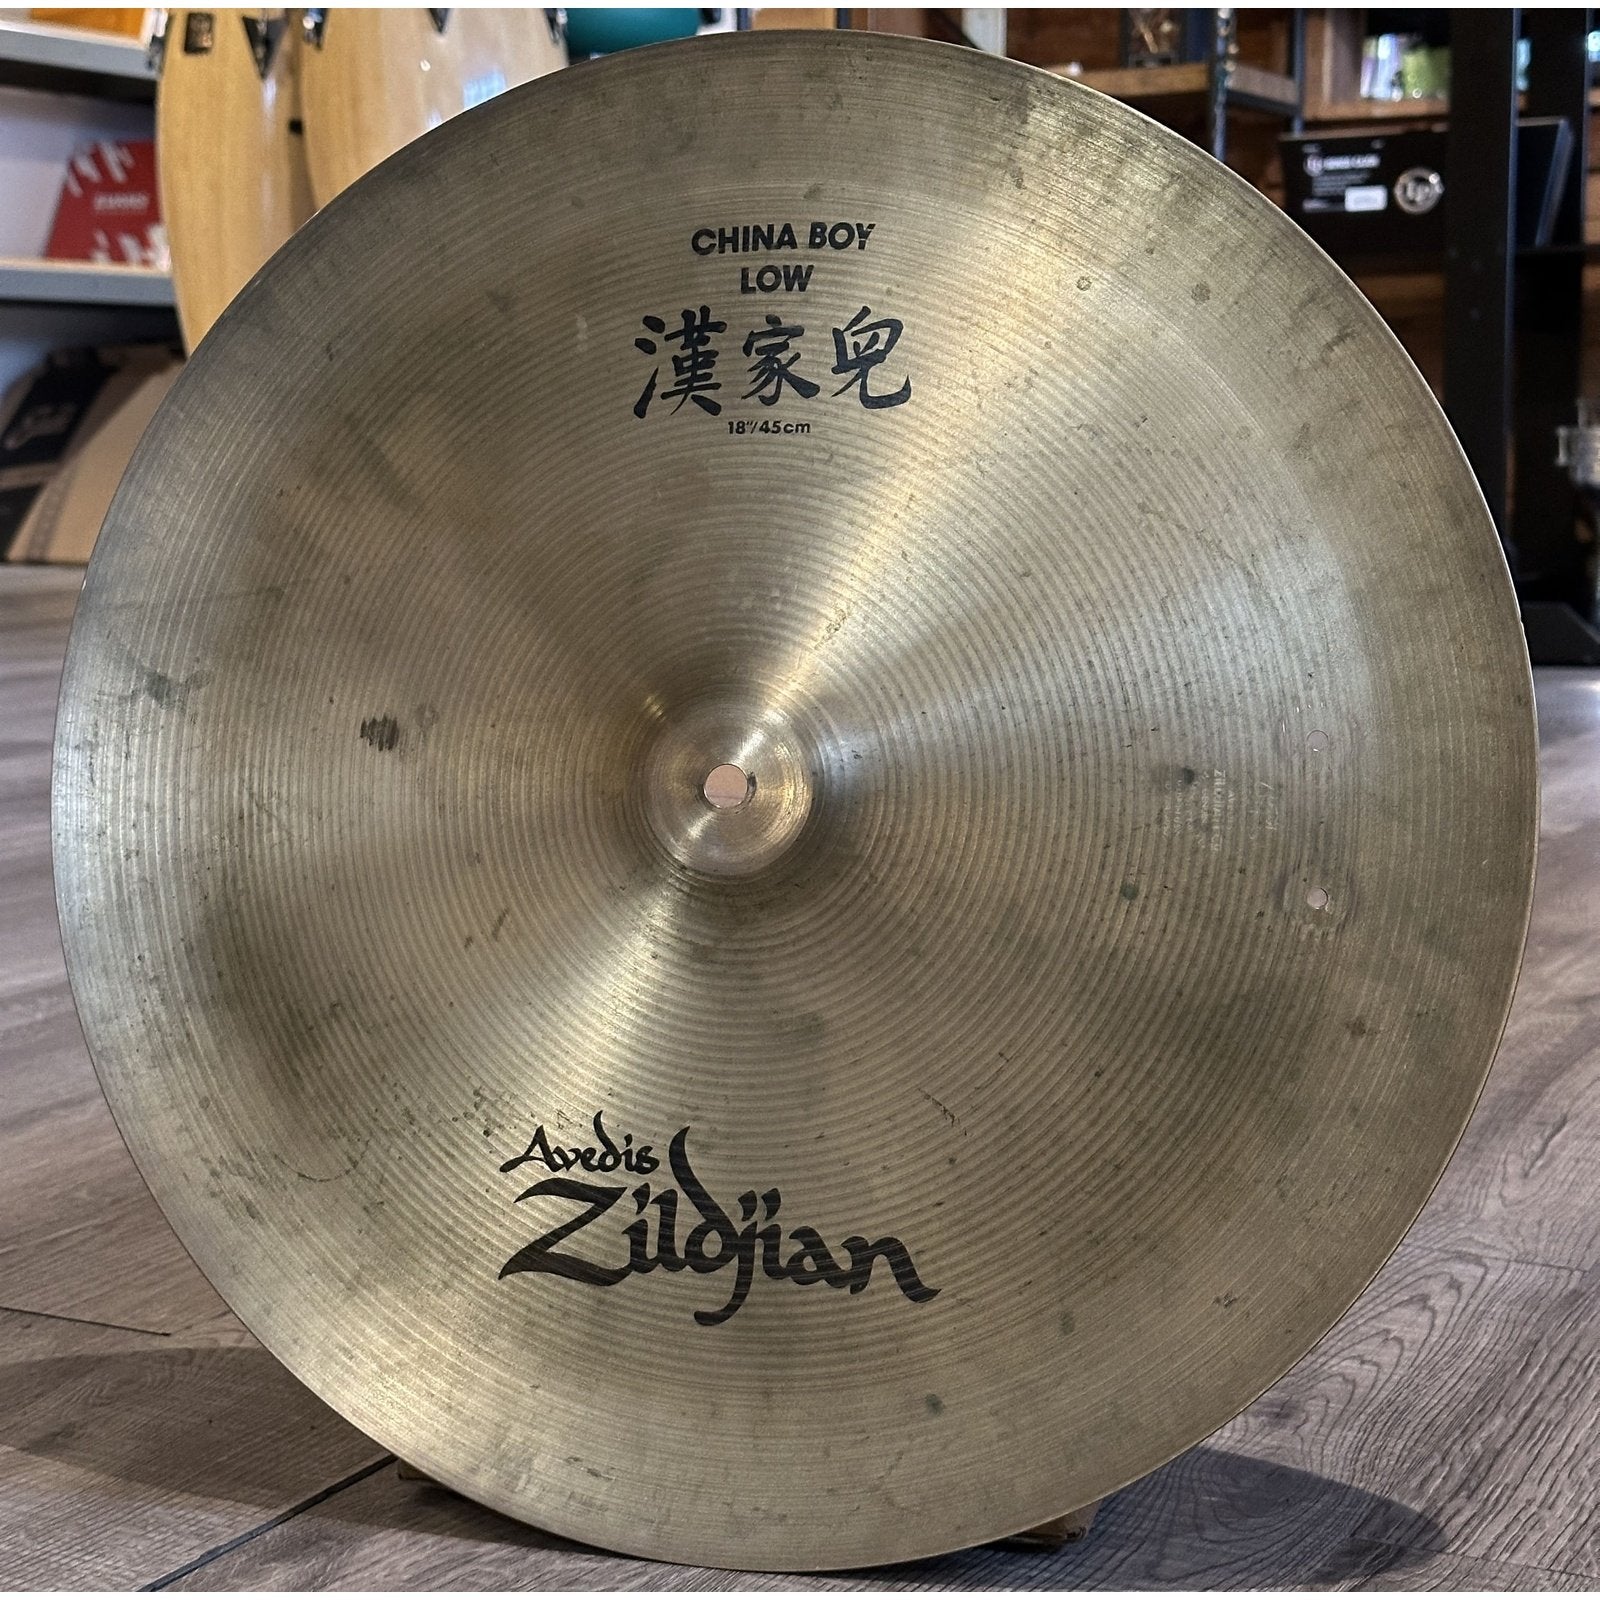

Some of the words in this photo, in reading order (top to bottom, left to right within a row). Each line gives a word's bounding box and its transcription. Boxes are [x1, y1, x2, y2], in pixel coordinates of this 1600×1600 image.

[691, 222, 798, 256] CHINA
[808, 221, 876, 250] BOY
[740, 264, 815, 294] LOW
[499, 1110, 661, 1175] Avedis
[498, 1125, 941, 1326] Zildjian
